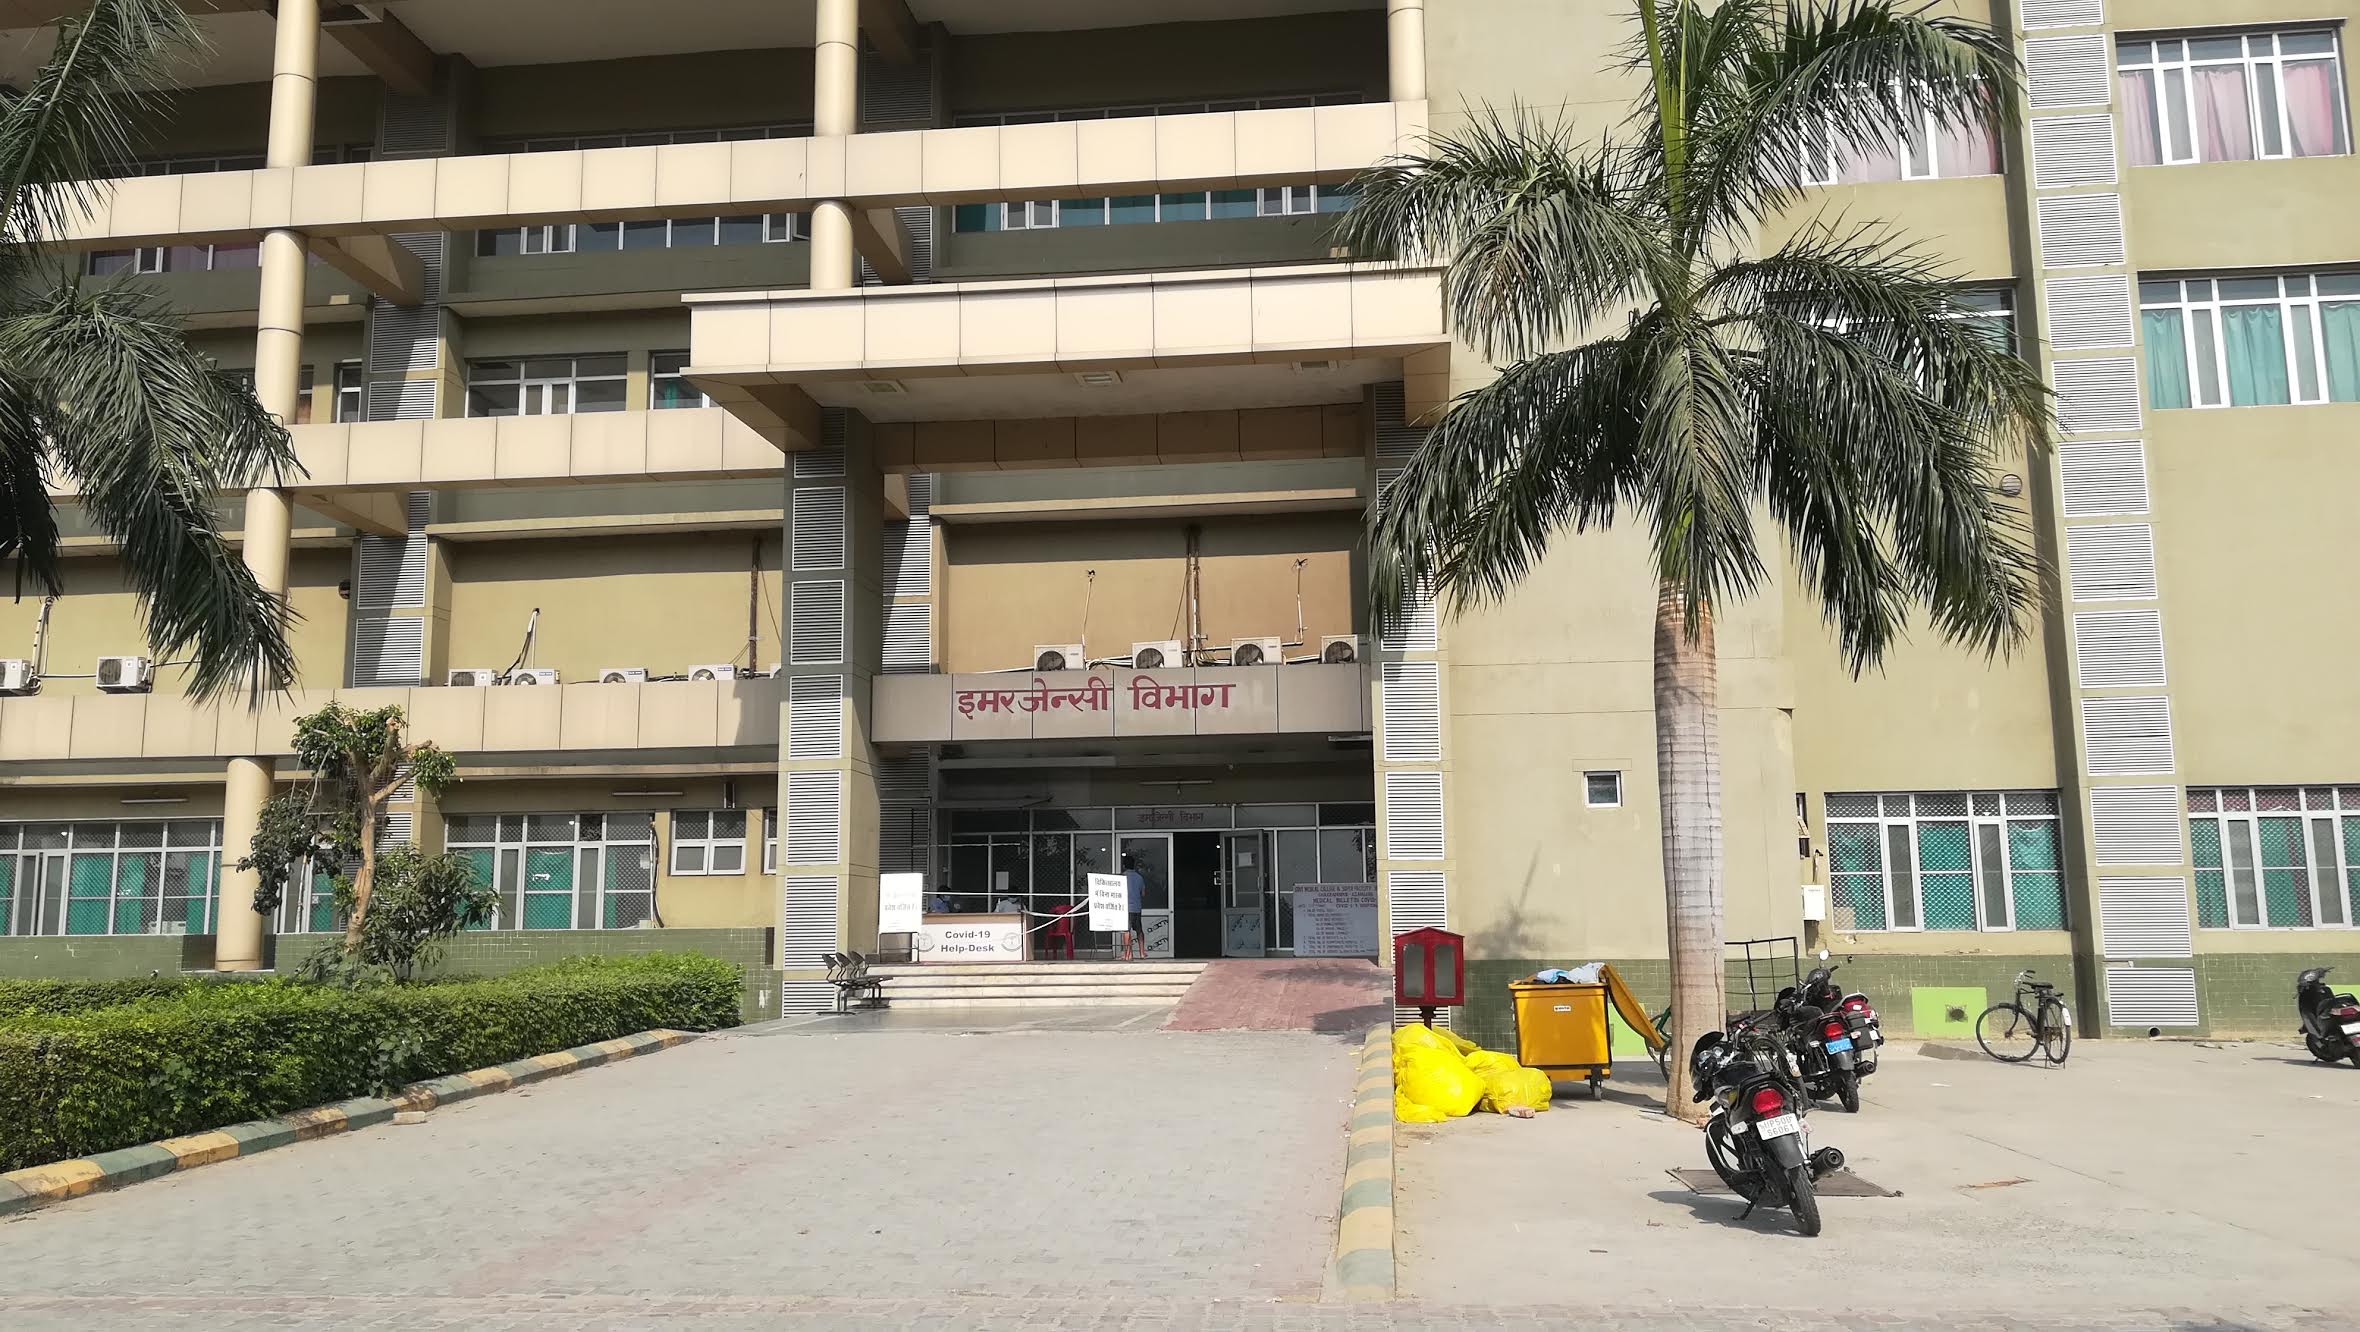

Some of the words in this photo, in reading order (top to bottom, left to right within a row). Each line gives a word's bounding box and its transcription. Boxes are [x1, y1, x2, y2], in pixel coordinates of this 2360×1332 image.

[956, 676, 1114, 720] इमरजेन्सी
[1127, 674, 1237, 710] विभाग
[945, 930, 991, 939] Covid-19
[941, 944, 995, 954] Help-Desk
